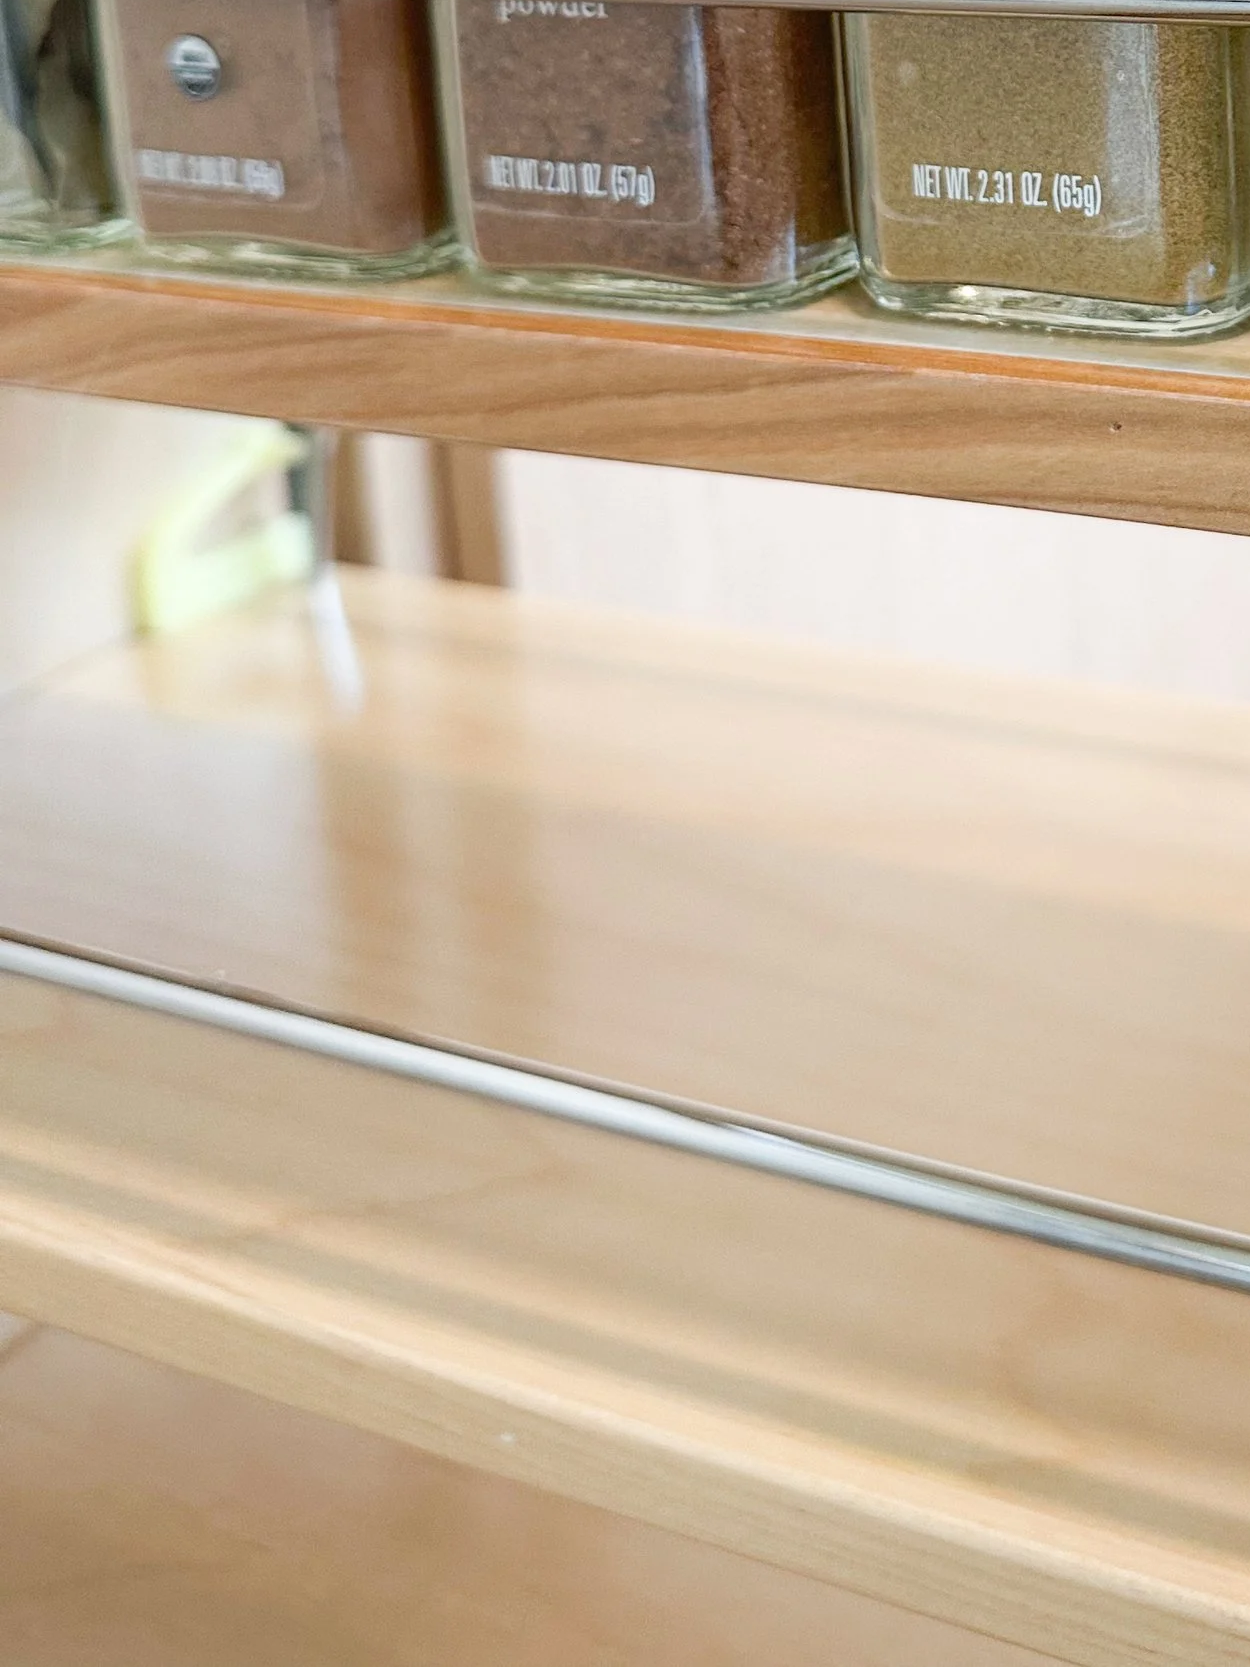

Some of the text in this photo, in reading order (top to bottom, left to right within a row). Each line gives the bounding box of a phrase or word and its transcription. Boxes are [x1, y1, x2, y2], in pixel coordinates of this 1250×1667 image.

[610, 164, 656, 208] (57g)
[912, 163, 1102, 218] NET WT. 2.31 OZ. (65g)
